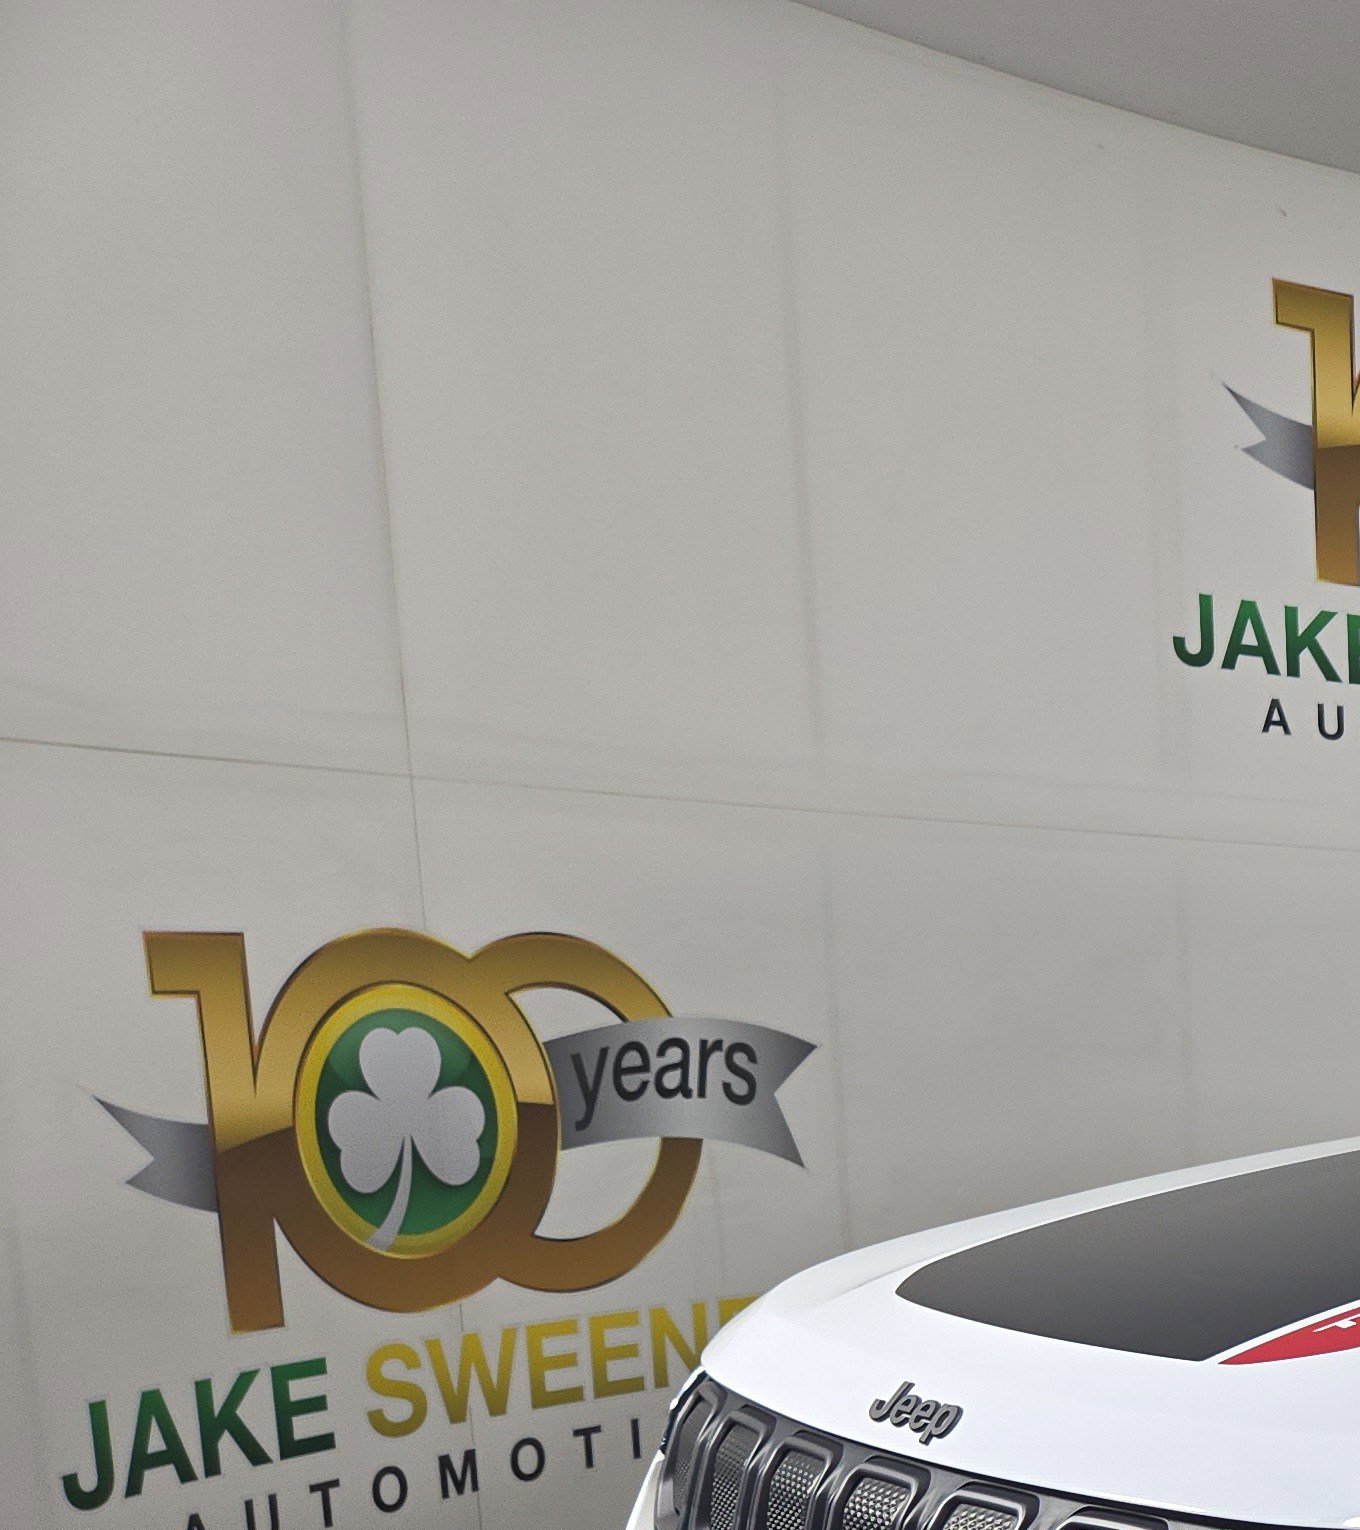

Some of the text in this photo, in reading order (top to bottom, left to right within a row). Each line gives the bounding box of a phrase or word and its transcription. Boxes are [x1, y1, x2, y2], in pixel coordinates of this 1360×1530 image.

[141, 927, 759, 1336] 100 years
[61, 1293, 760, 1511] JAKE SWEEN
[869, 1381, 963, 1446] Jeep
